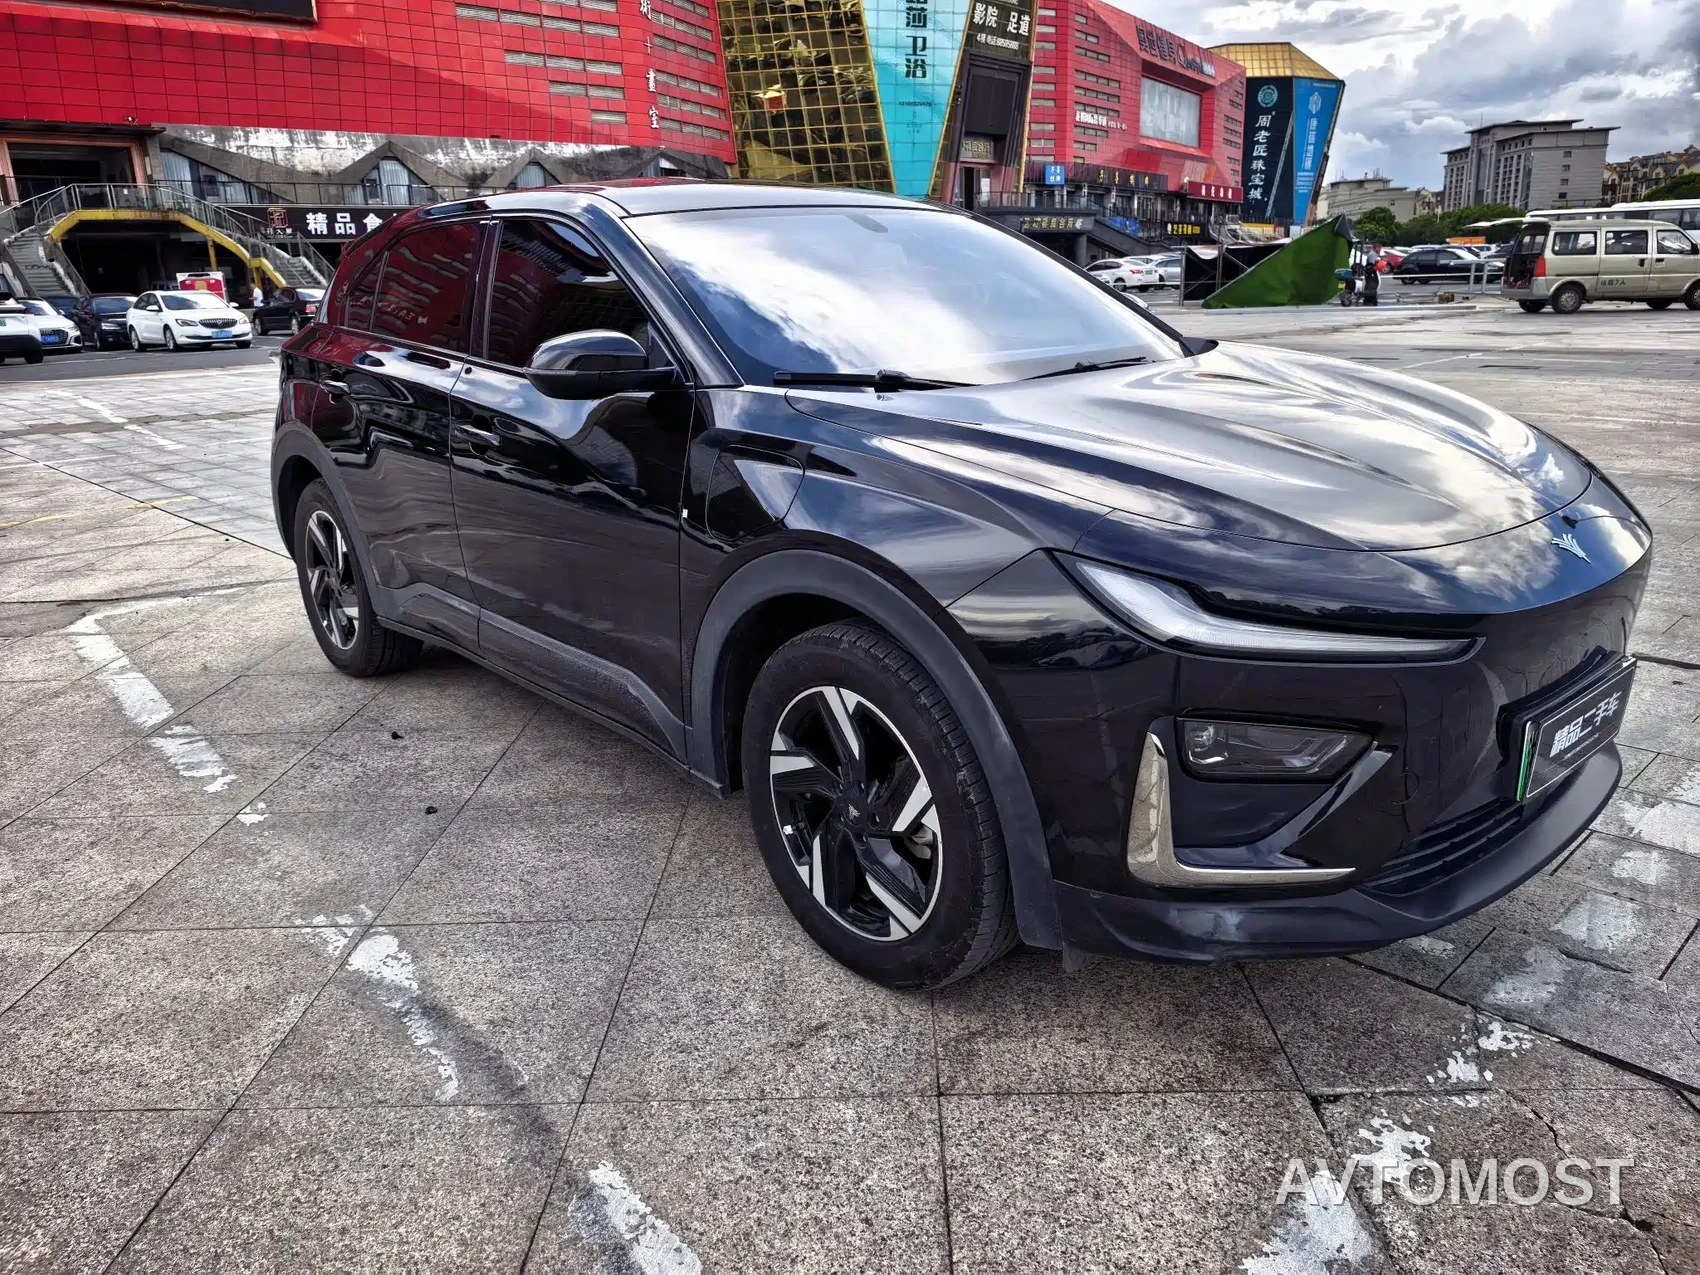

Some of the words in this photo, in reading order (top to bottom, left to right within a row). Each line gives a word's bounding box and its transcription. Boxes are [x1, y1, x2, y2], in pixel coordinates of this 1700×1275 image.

[905, 0, 928, 78] 莎卫浴
[973, 2, 998, 27] 影院
[1006, 11, 1031, 36] 足道
[1247, 115, 1271, 200] 周老匠珠宝城
[305, 212, 398, 235] 精品食
